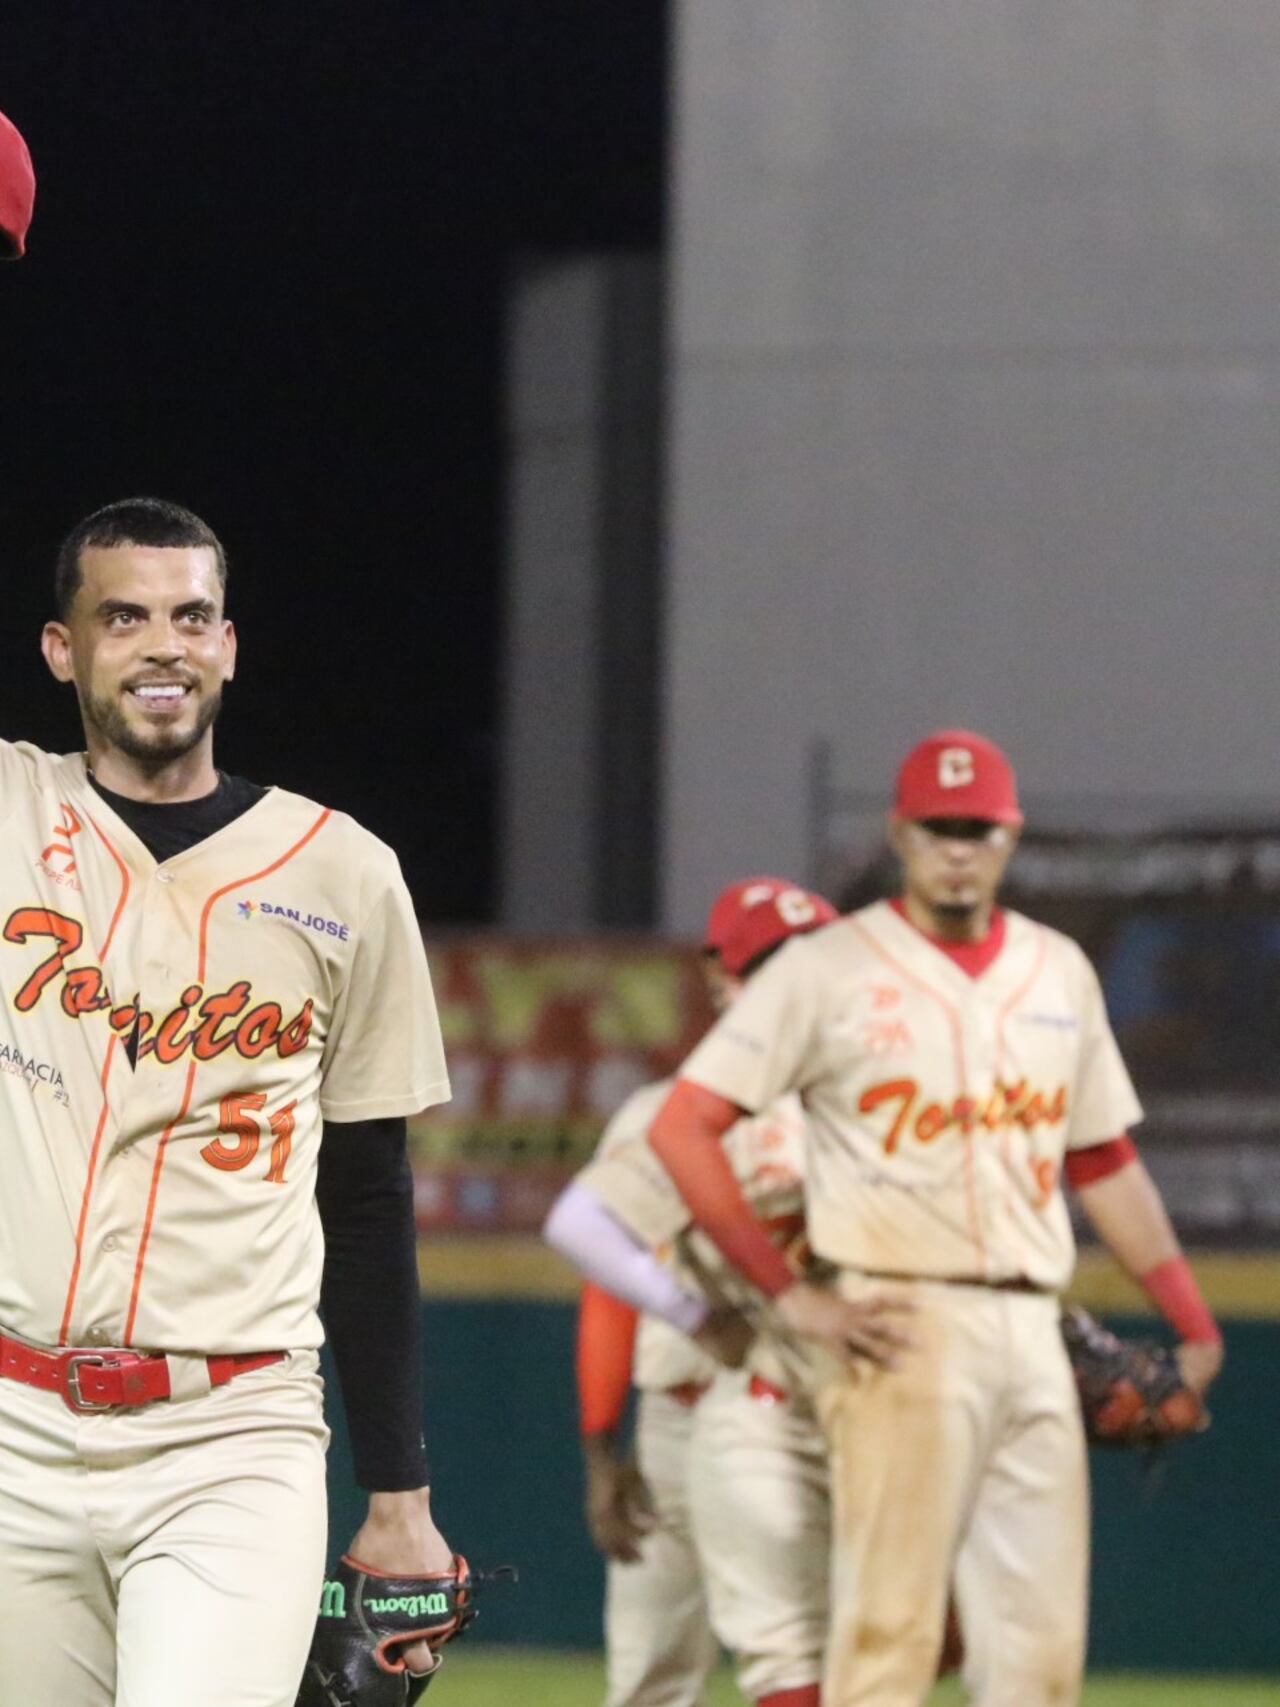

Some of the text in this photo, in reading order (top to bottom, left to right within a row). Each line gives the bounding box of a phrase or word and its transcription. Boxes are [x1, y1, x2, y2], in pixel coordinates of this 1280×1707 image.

[260, 903, 349, 941] SAN JOSÉ
[3, 907, 314, 1064] Toritos
[200, 1090, 297, 1184] 51
[363, 1593, 448, 1617] Wilson
